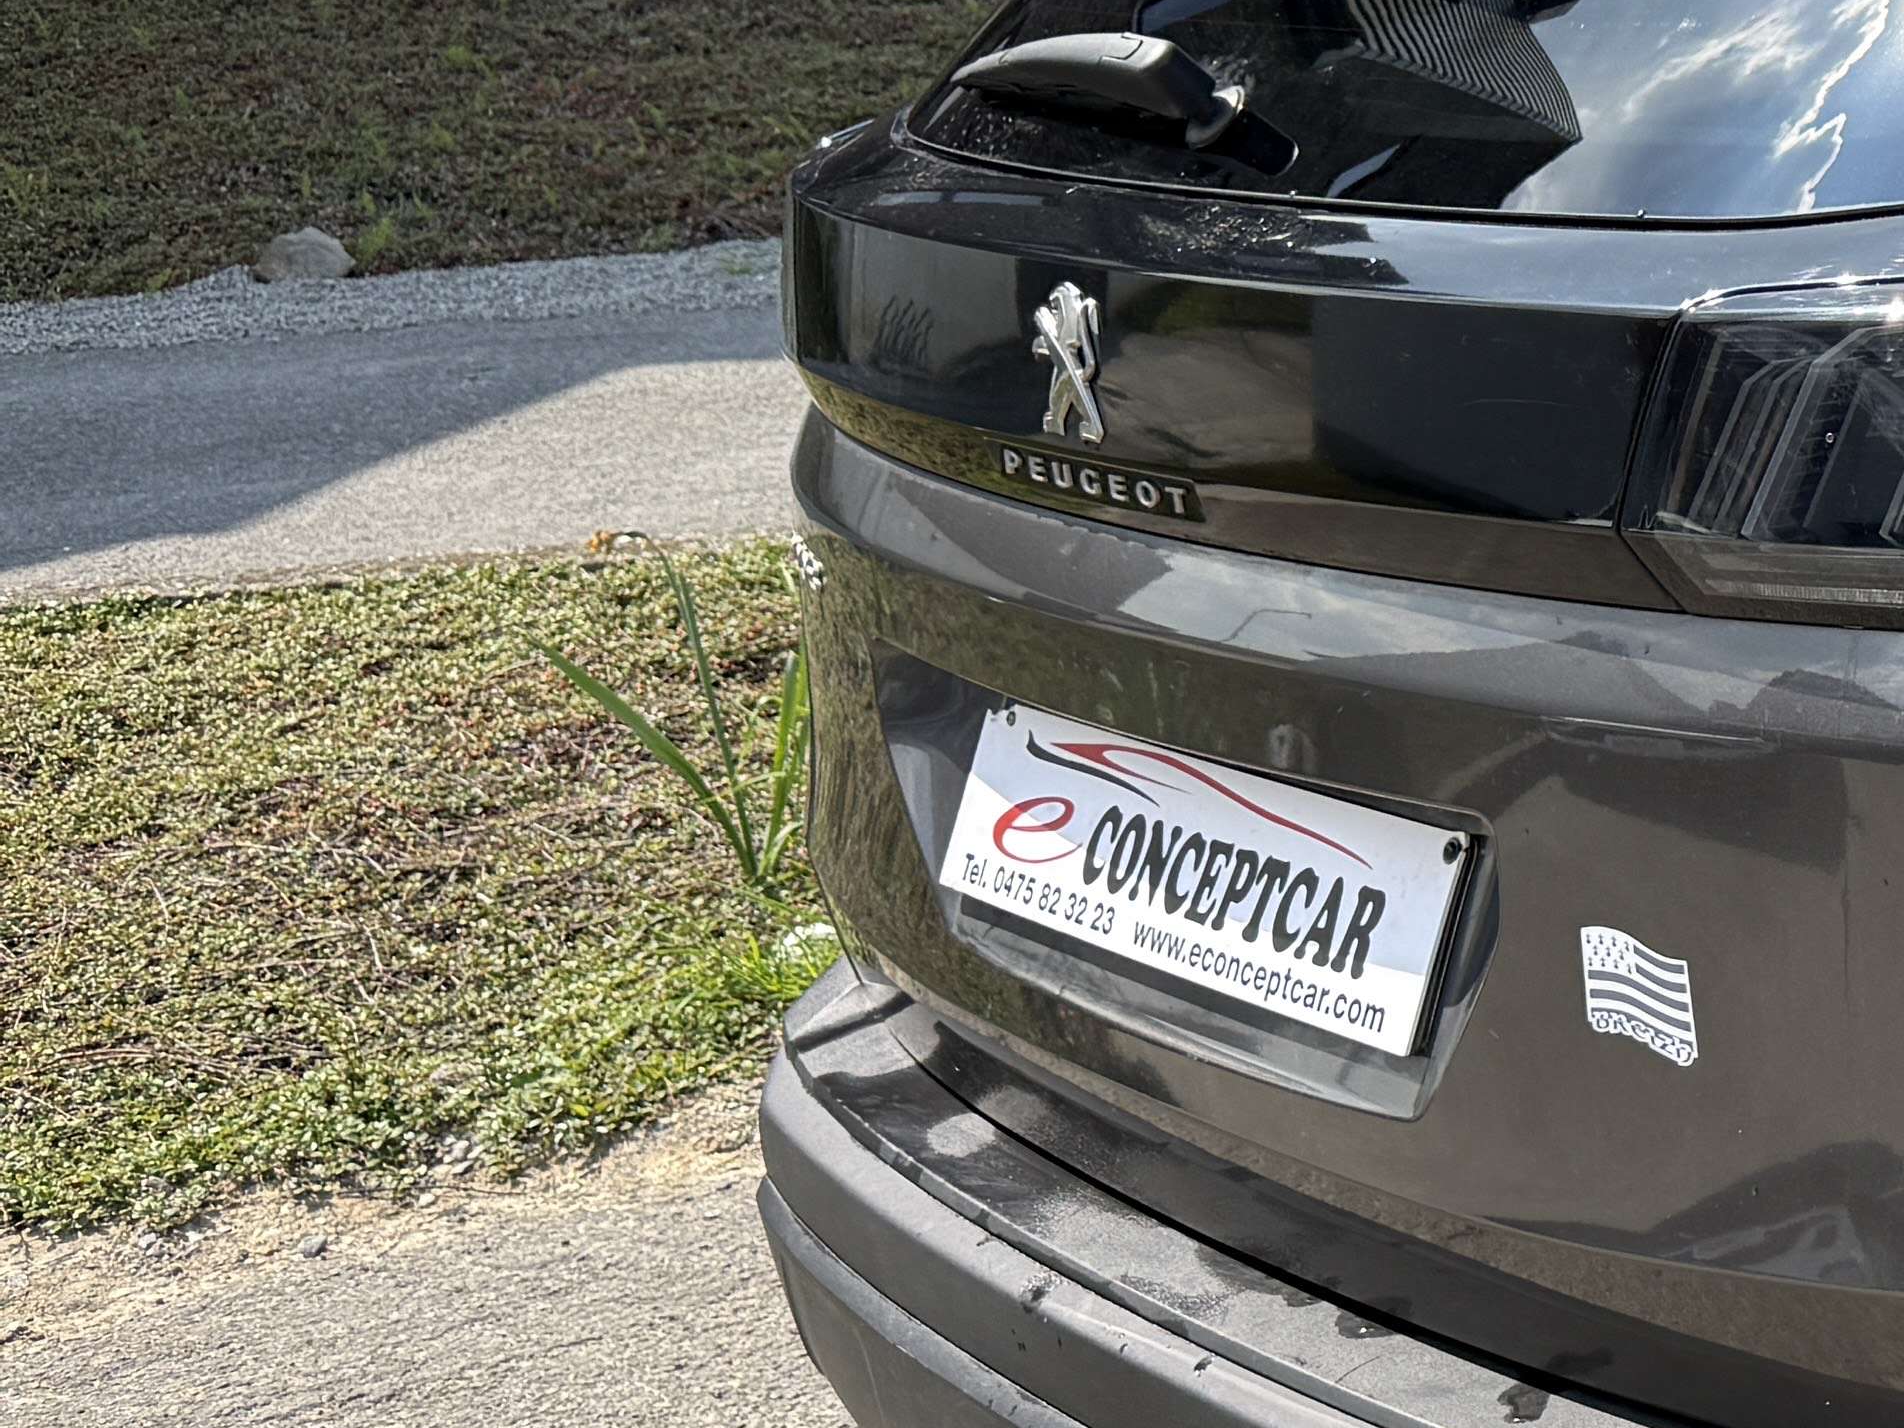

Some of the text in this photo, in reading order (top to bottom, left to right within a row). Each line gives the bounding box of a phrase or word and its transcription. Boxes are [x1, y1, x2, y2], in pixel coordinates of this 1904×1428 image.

[1003, 448, 1188, 514] PEUGEOT
[962, 853, 1386, 1033] Tel. 0475 82 32 23 www.econceptcar.com
